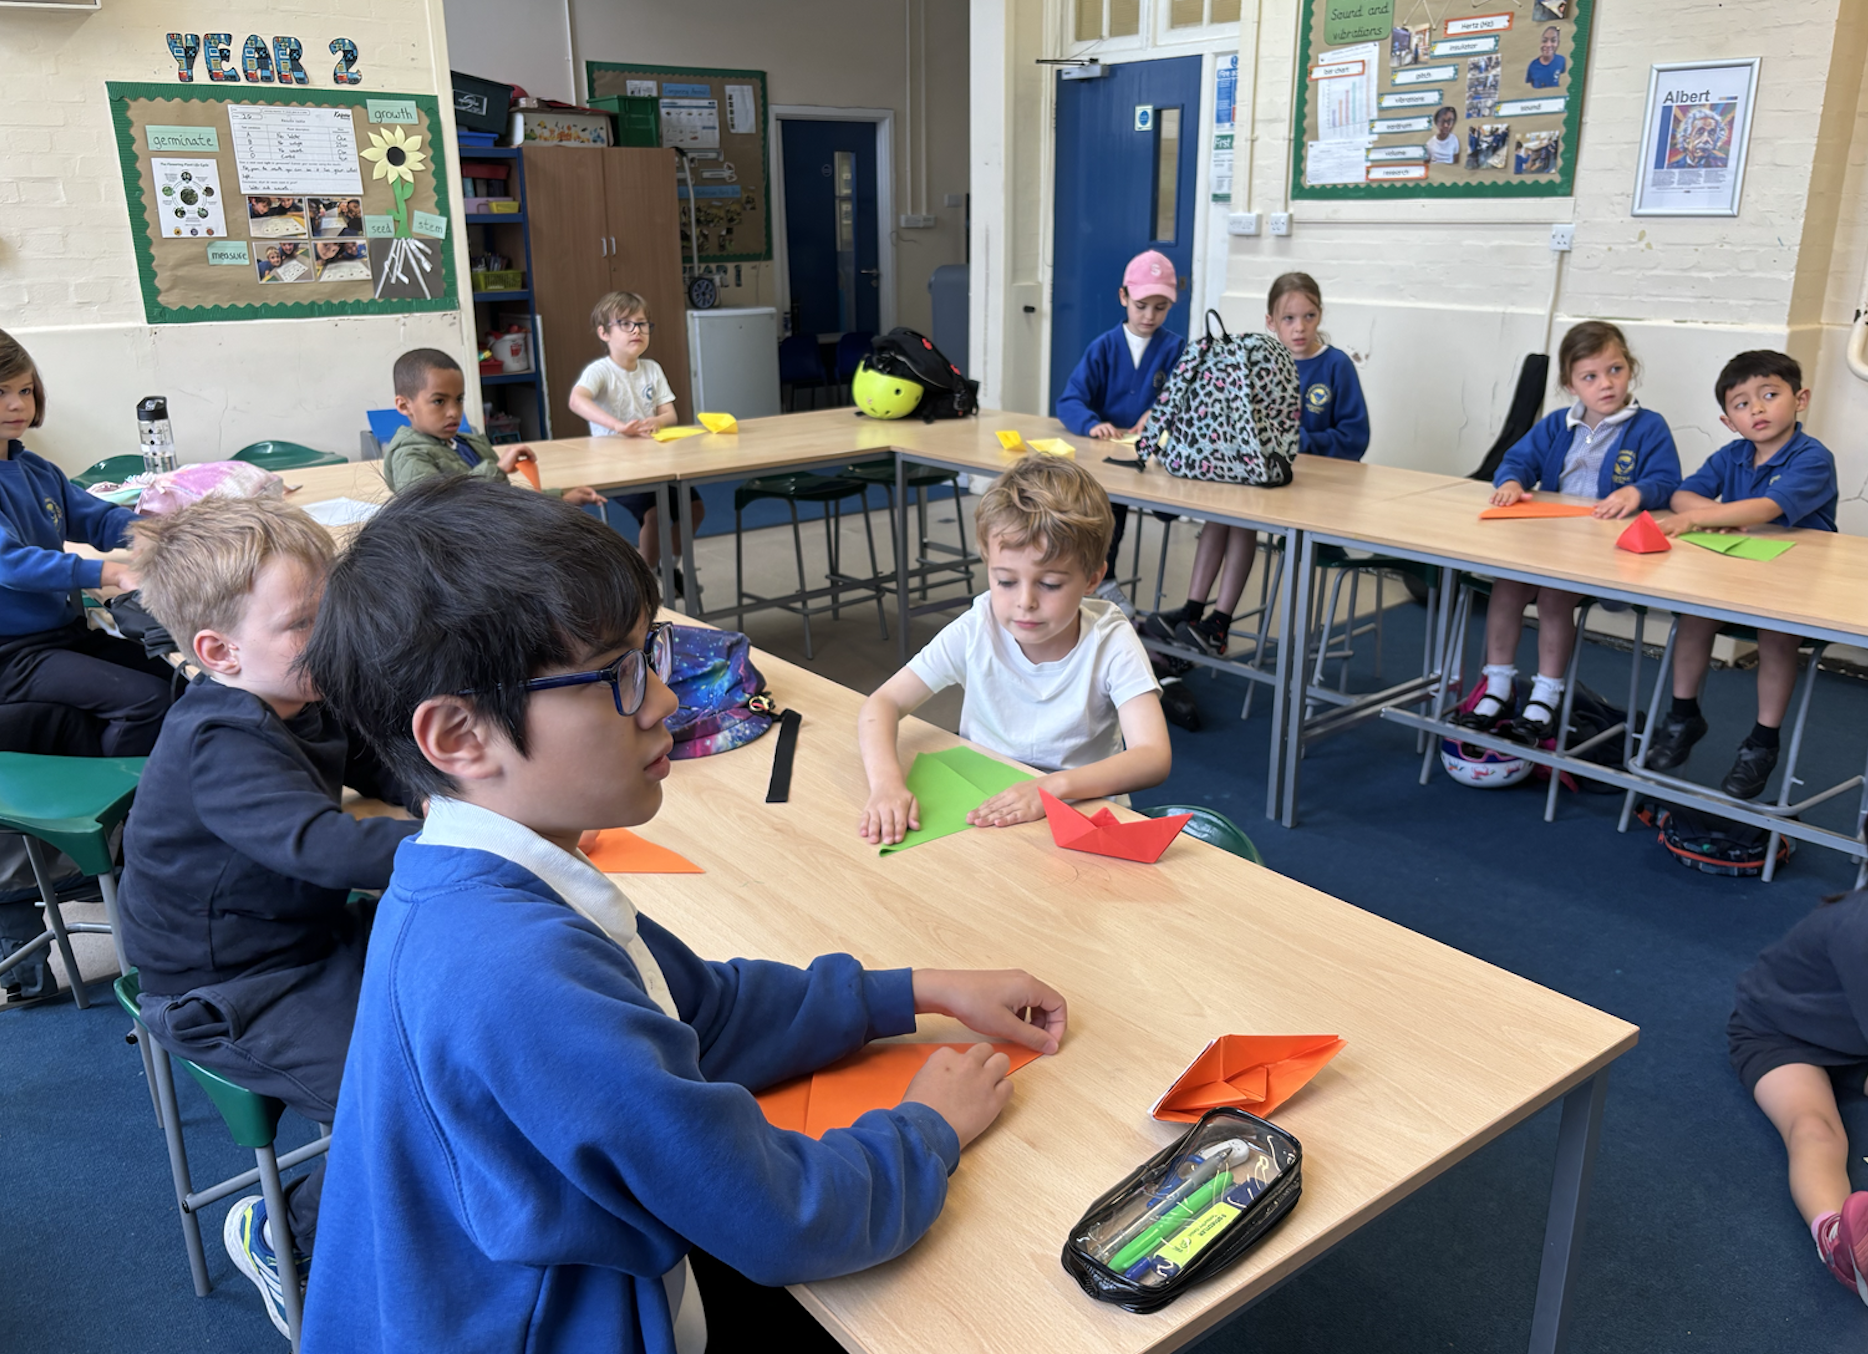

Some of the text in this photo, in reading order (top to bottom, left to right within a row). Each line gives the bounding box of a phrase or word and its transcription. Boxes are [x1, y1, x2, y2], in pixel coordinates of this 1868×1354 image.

[1331, 2, 1389, 20] Sound and
[1333, 27, 1382, 40] vibrations
[1449, 43, 1478, 51] insulator
[166, 33, 362, 84] YEAR 2
[1415, 72, 1431, 80] pitch
[1663, 89, 1710, 104] Albert
[1521, 103, 1541, 111] sound
[374, 106, 413, 125] growth
[1387, 122, 1412, 130] eardrum
[152, 133, 214, 149] germinate
[1214, 137, 1231, 149] First
[1385, 149, 1406, 157] volume
[370, 221, 392, 235] seed
[417, 220, 443, 234] stem
[211, 250, 248, 263] measure
